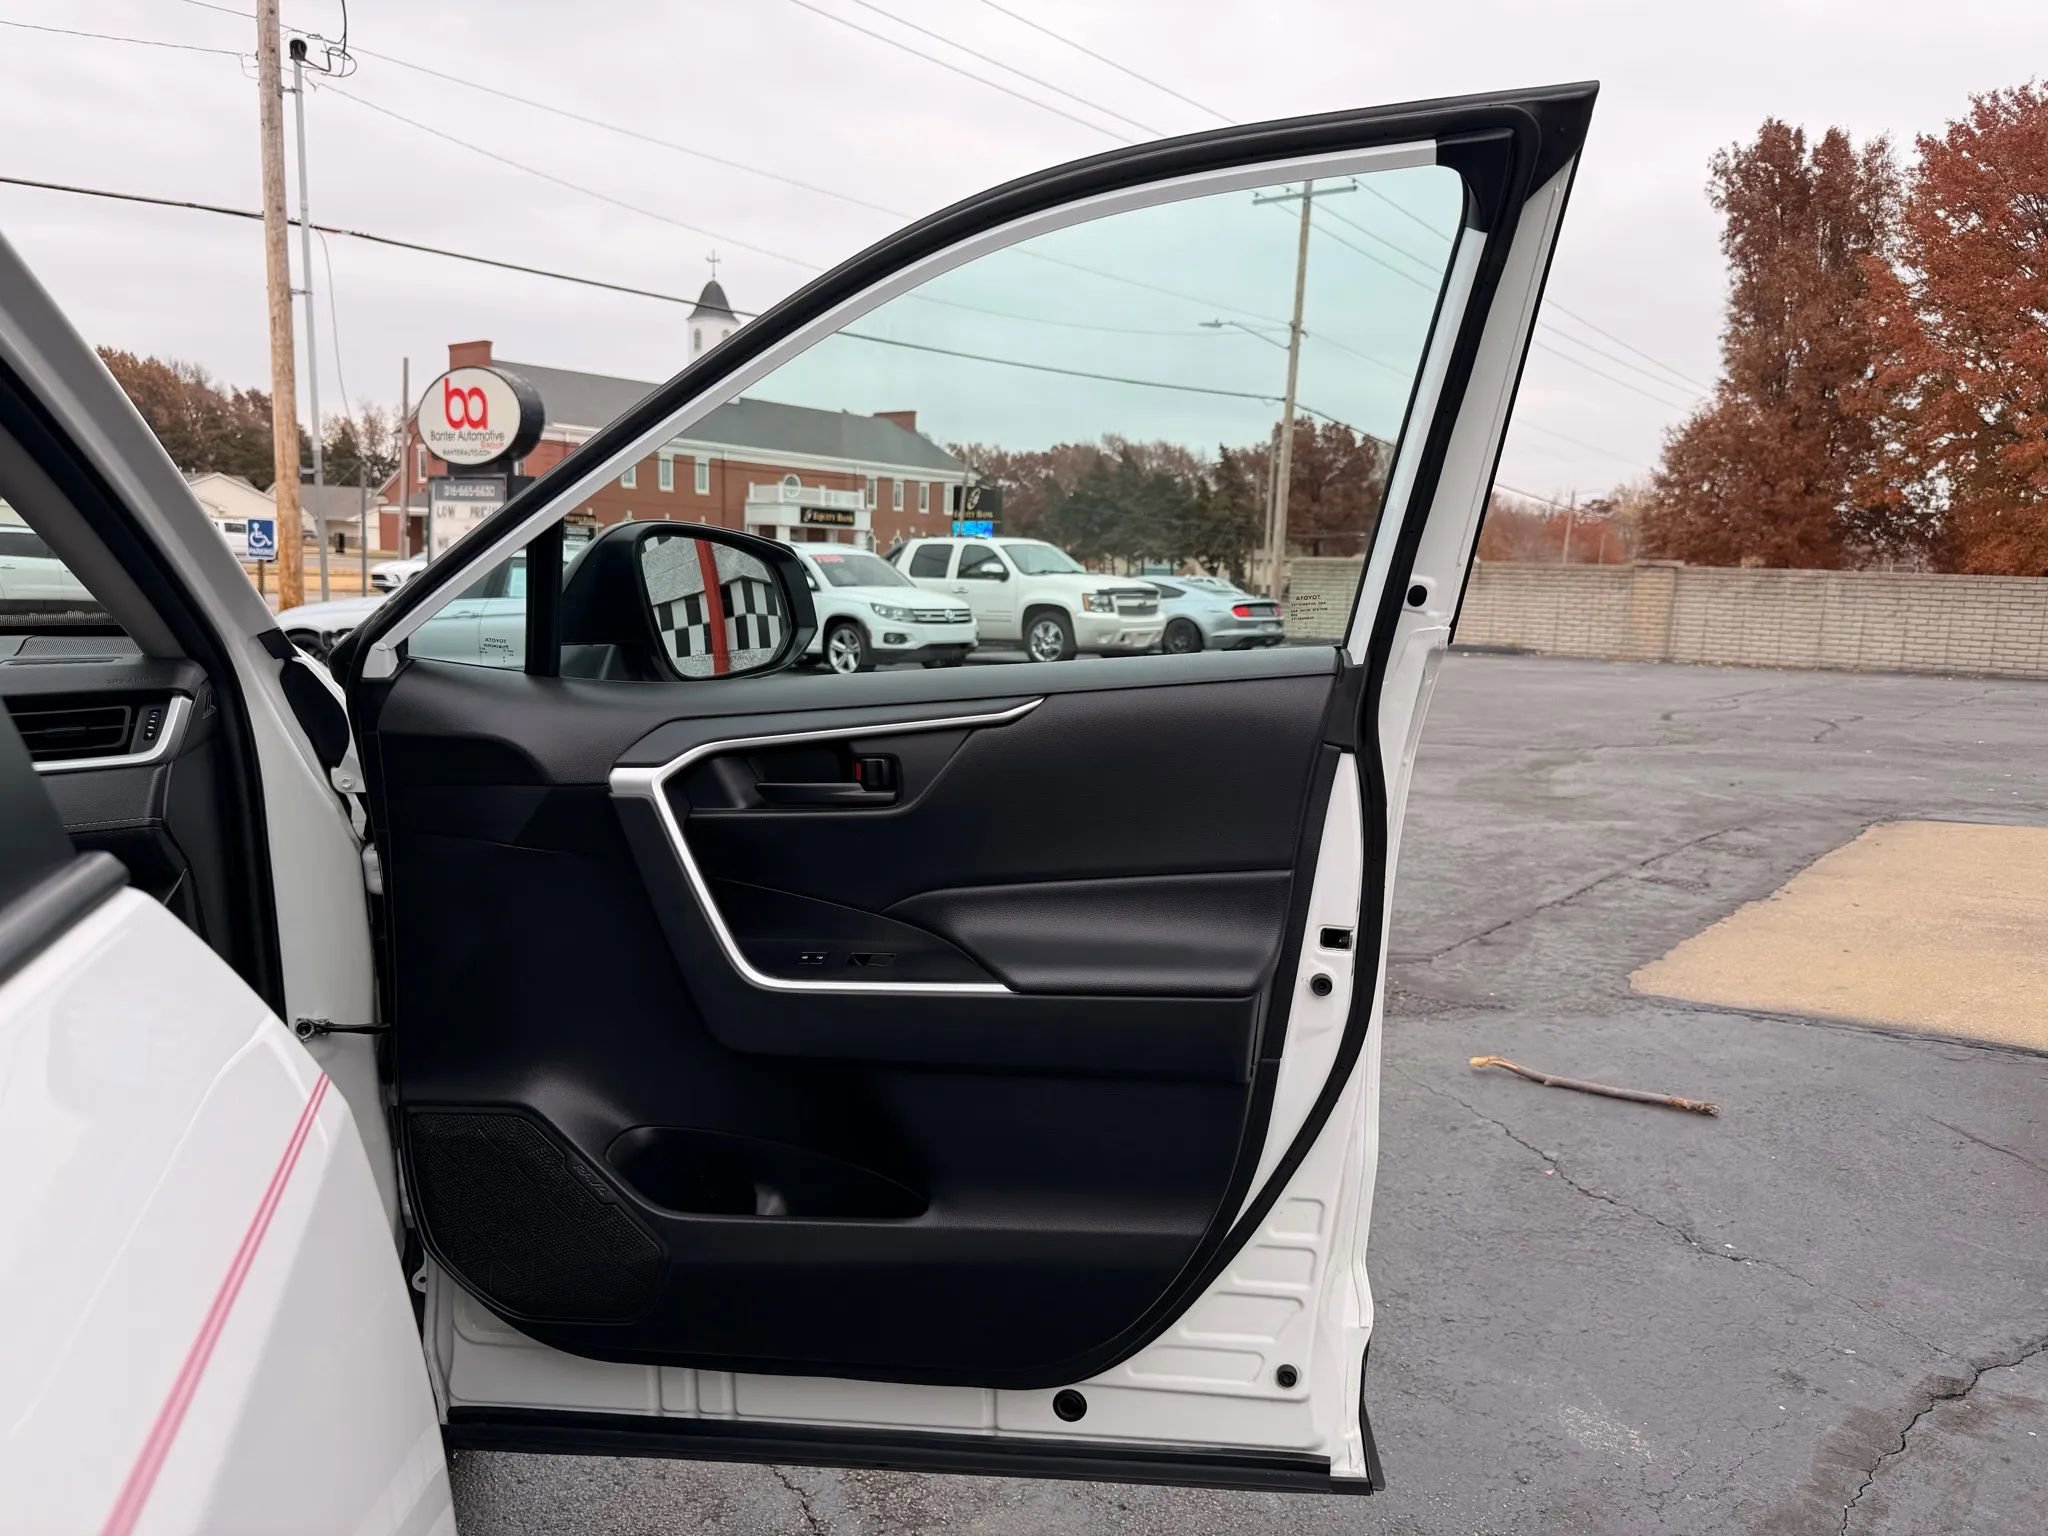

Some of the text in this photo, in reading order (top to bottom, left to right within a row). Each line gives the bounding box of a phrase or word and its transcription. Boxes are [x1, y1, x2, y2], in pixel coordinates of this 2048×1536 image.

[430, 431, 504, 441] Banter Automotive
[437, 504, 455, 518] LOW
